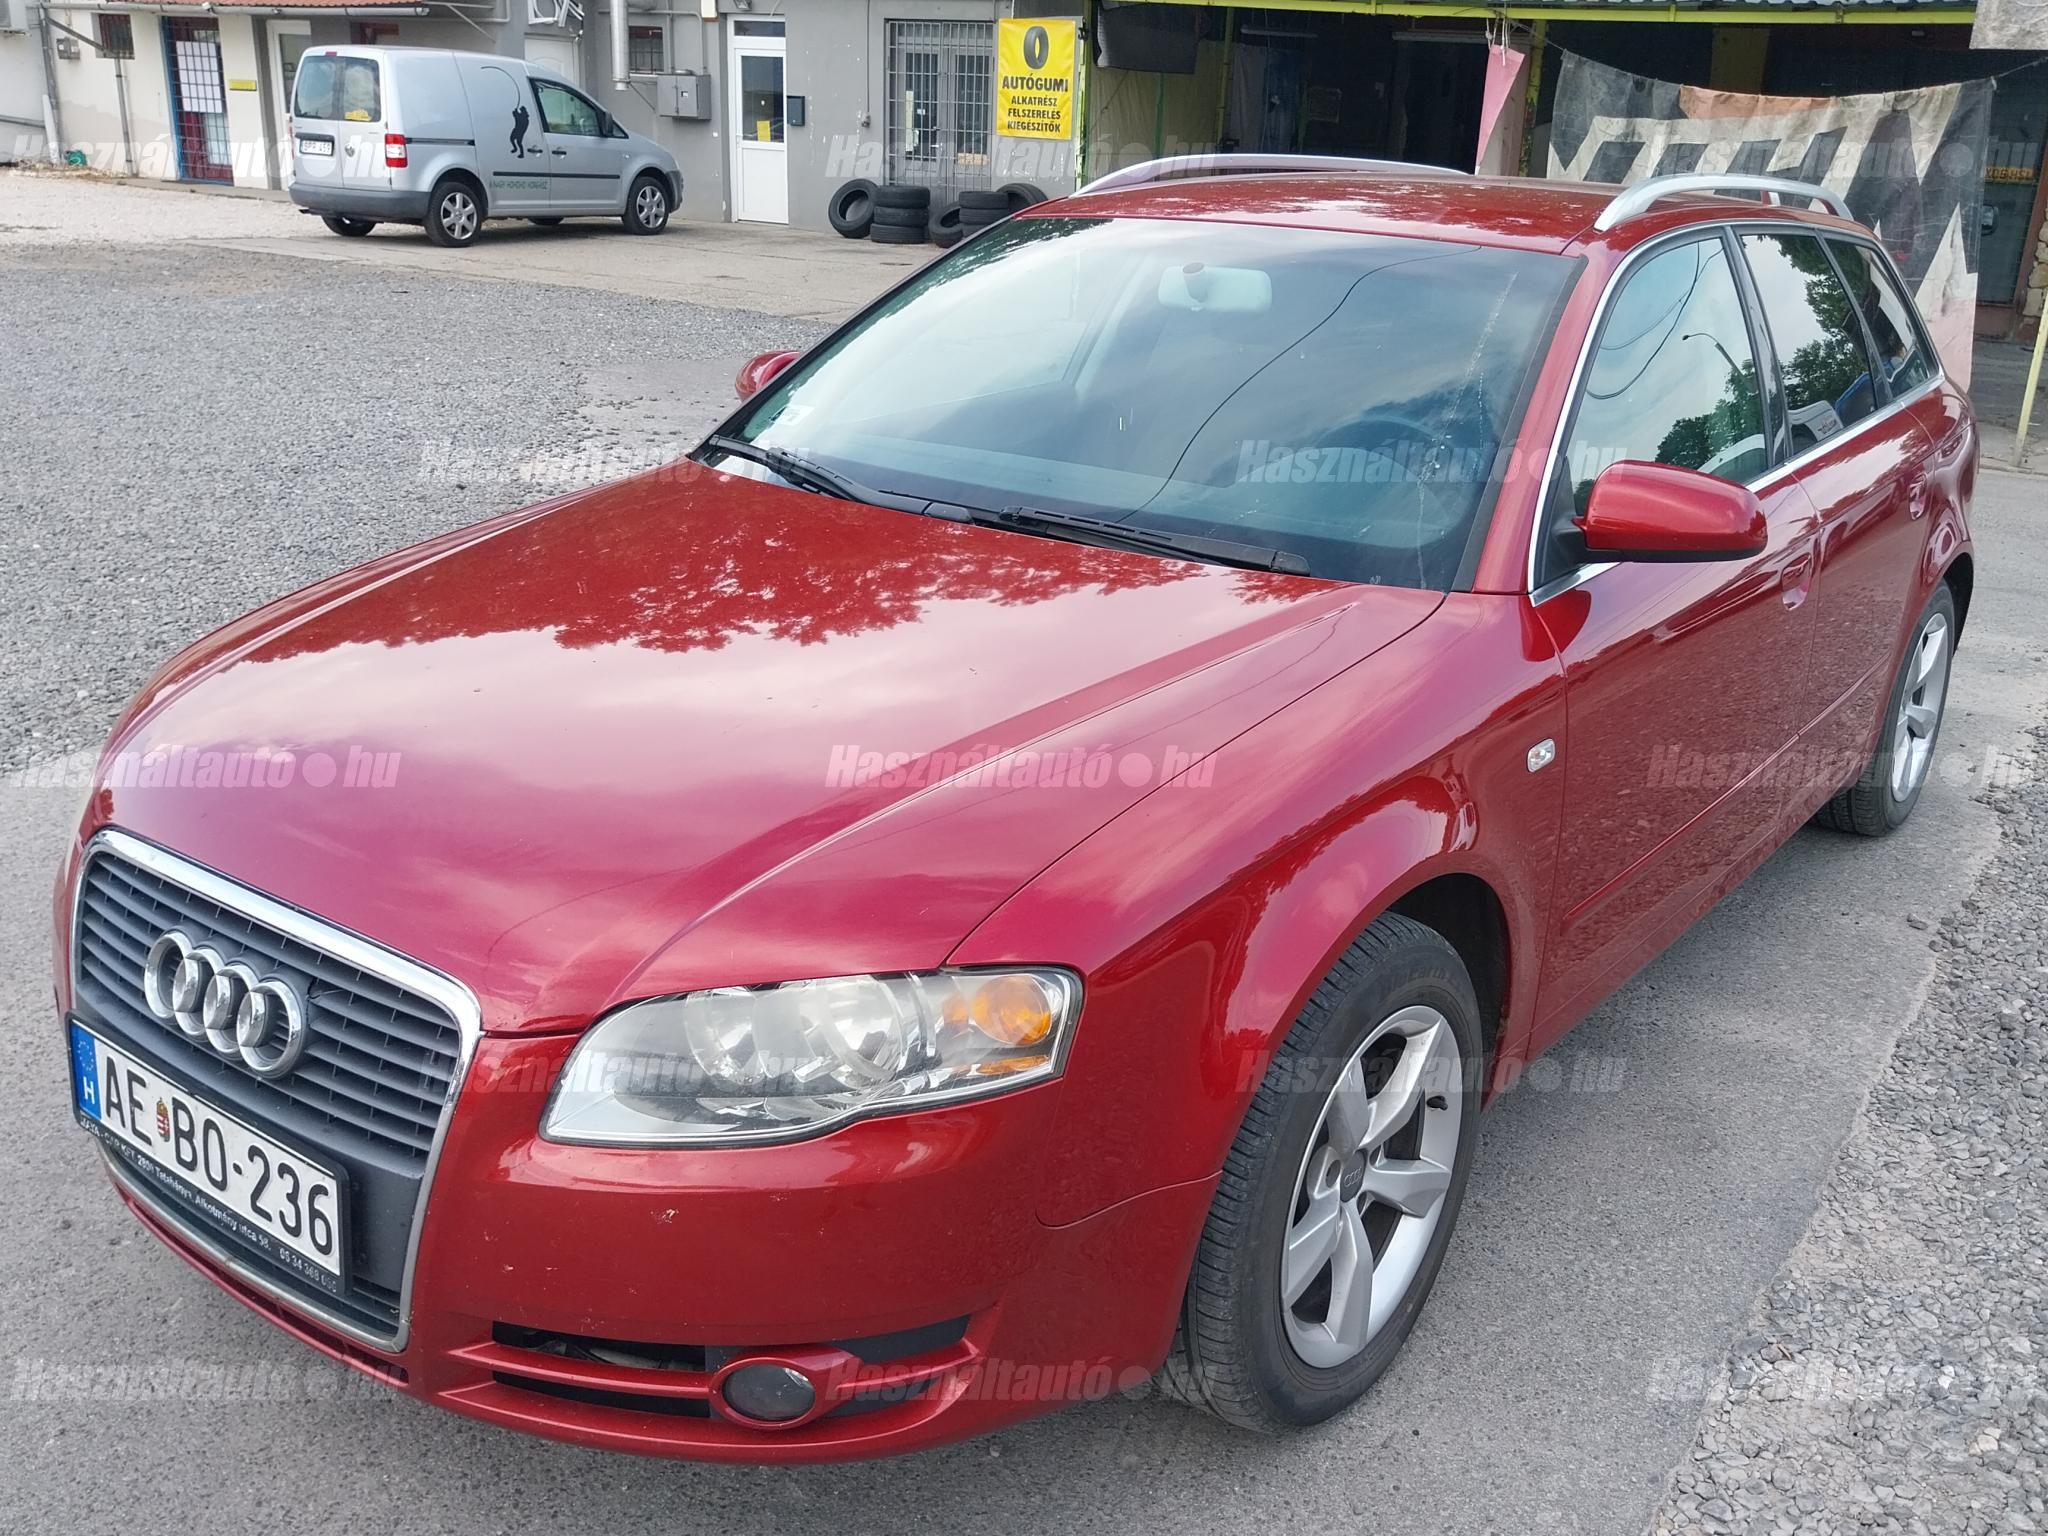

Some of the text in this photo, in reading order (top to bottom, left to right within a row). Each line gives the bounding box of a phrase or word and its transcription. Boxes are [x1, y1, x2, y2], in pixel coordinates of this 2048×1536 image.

[1002, 74, 1068, 92] AUTÓGUMI
[1011, 94, 1057, 107] ALKATRÉSZ
[1008, 108, 1061, 119] FELSZERELÉS
[1007, 120, 1061, 133] KIEGÉSZÍTŐK
[83, 1077, 95, 1105] H
